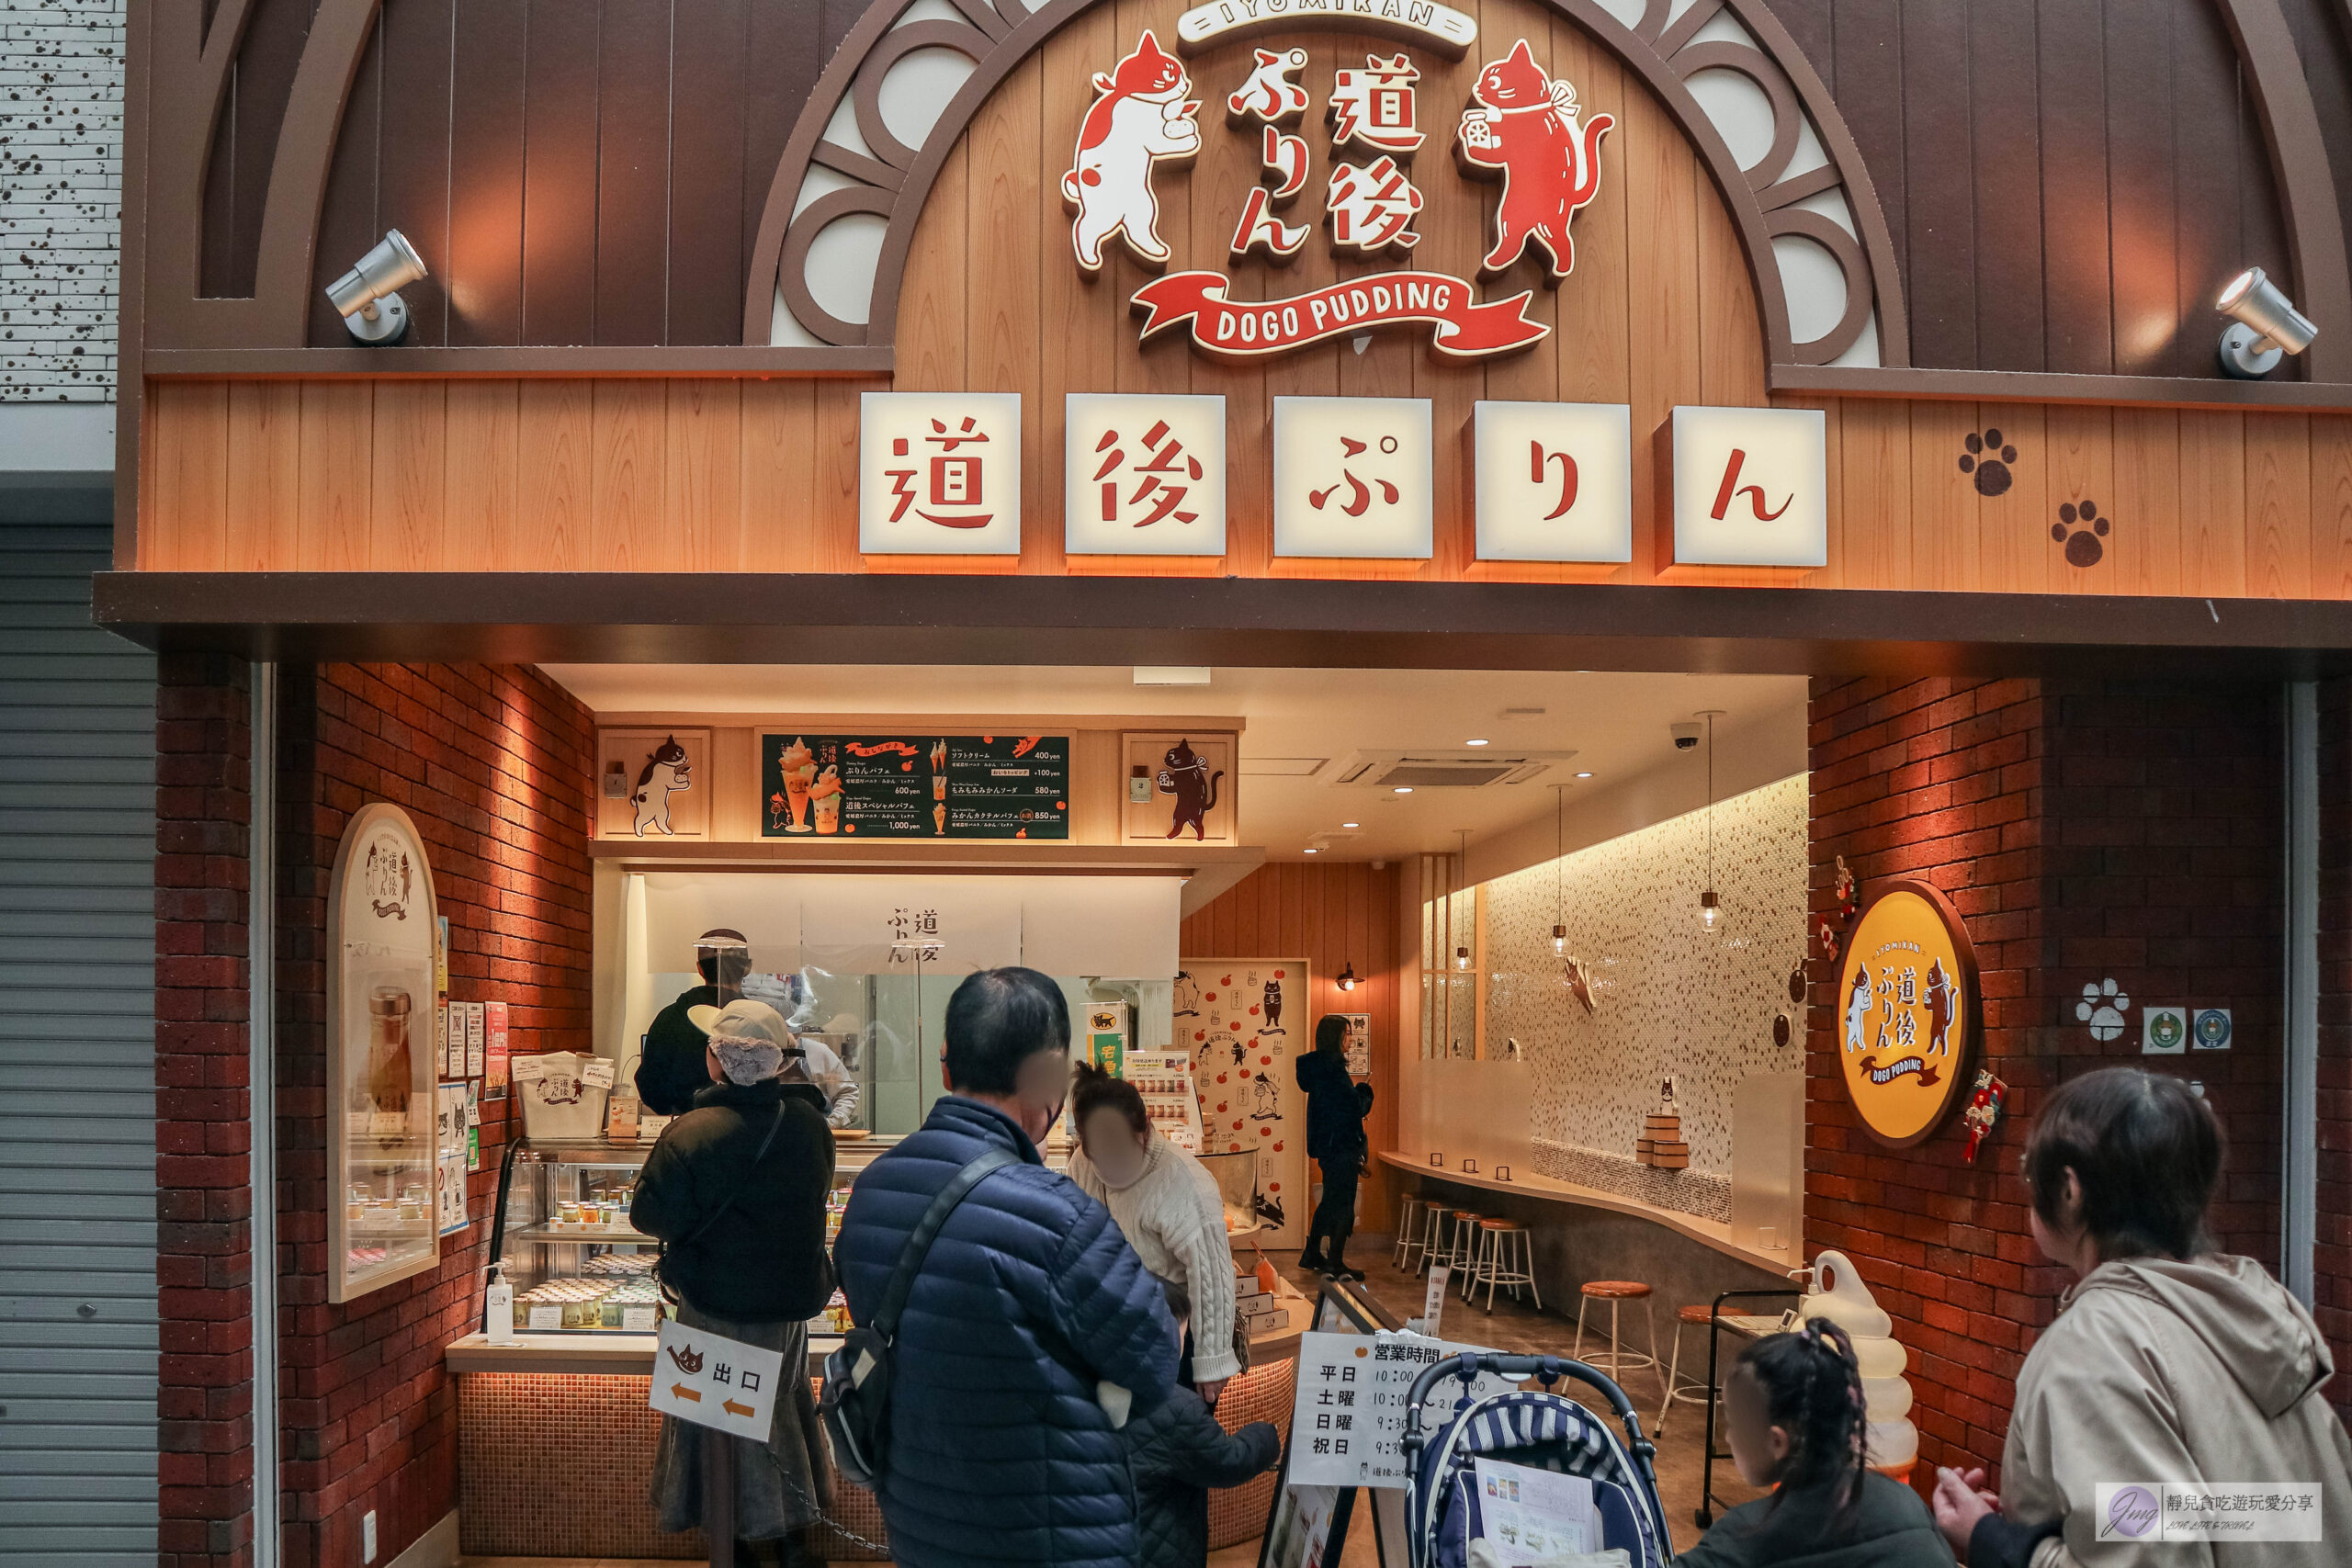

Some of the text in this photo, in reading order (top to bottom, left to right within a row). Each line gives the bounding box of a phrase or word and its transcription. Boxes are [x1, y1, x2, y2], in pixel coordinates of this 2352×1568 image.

[1228, 48, 1311, 256] ぷりん
[1327, 52, 1428, 251] 道後
[1217, 283, 1452, 342] DOGO PUDDING
[885, 417, 1793, 528] 道後ぷりん
[895, 786, 909, 795] 600
[1035, 786, 1049, 795] 580
[845, 801, 915, 810] 道後スペシャルパフェ
[889, 821, 909, 829] 1,000
[1876, 940, 1921, 957] IYOMIKAN
[1877, 965, 1894, 1048] ぷりん
[1896, 965, 1917, 1046] 道後
[1102, 1045, 1116, 1078] 宅急
[1872, 1058, 1922, 1082] DOGO PUDDING
[1374, 1344, 1441, 1364] 営業時間
[713, 1362, 761, 1393] 出口
[1319, 1365, 1356, 1382] 平日
[1317, 1390, 1355, 1406] 土曜
[1317, 1414, 1352, 1431] 日曜
[1313, 1438, 1398, 1455] 祝日 9:3
